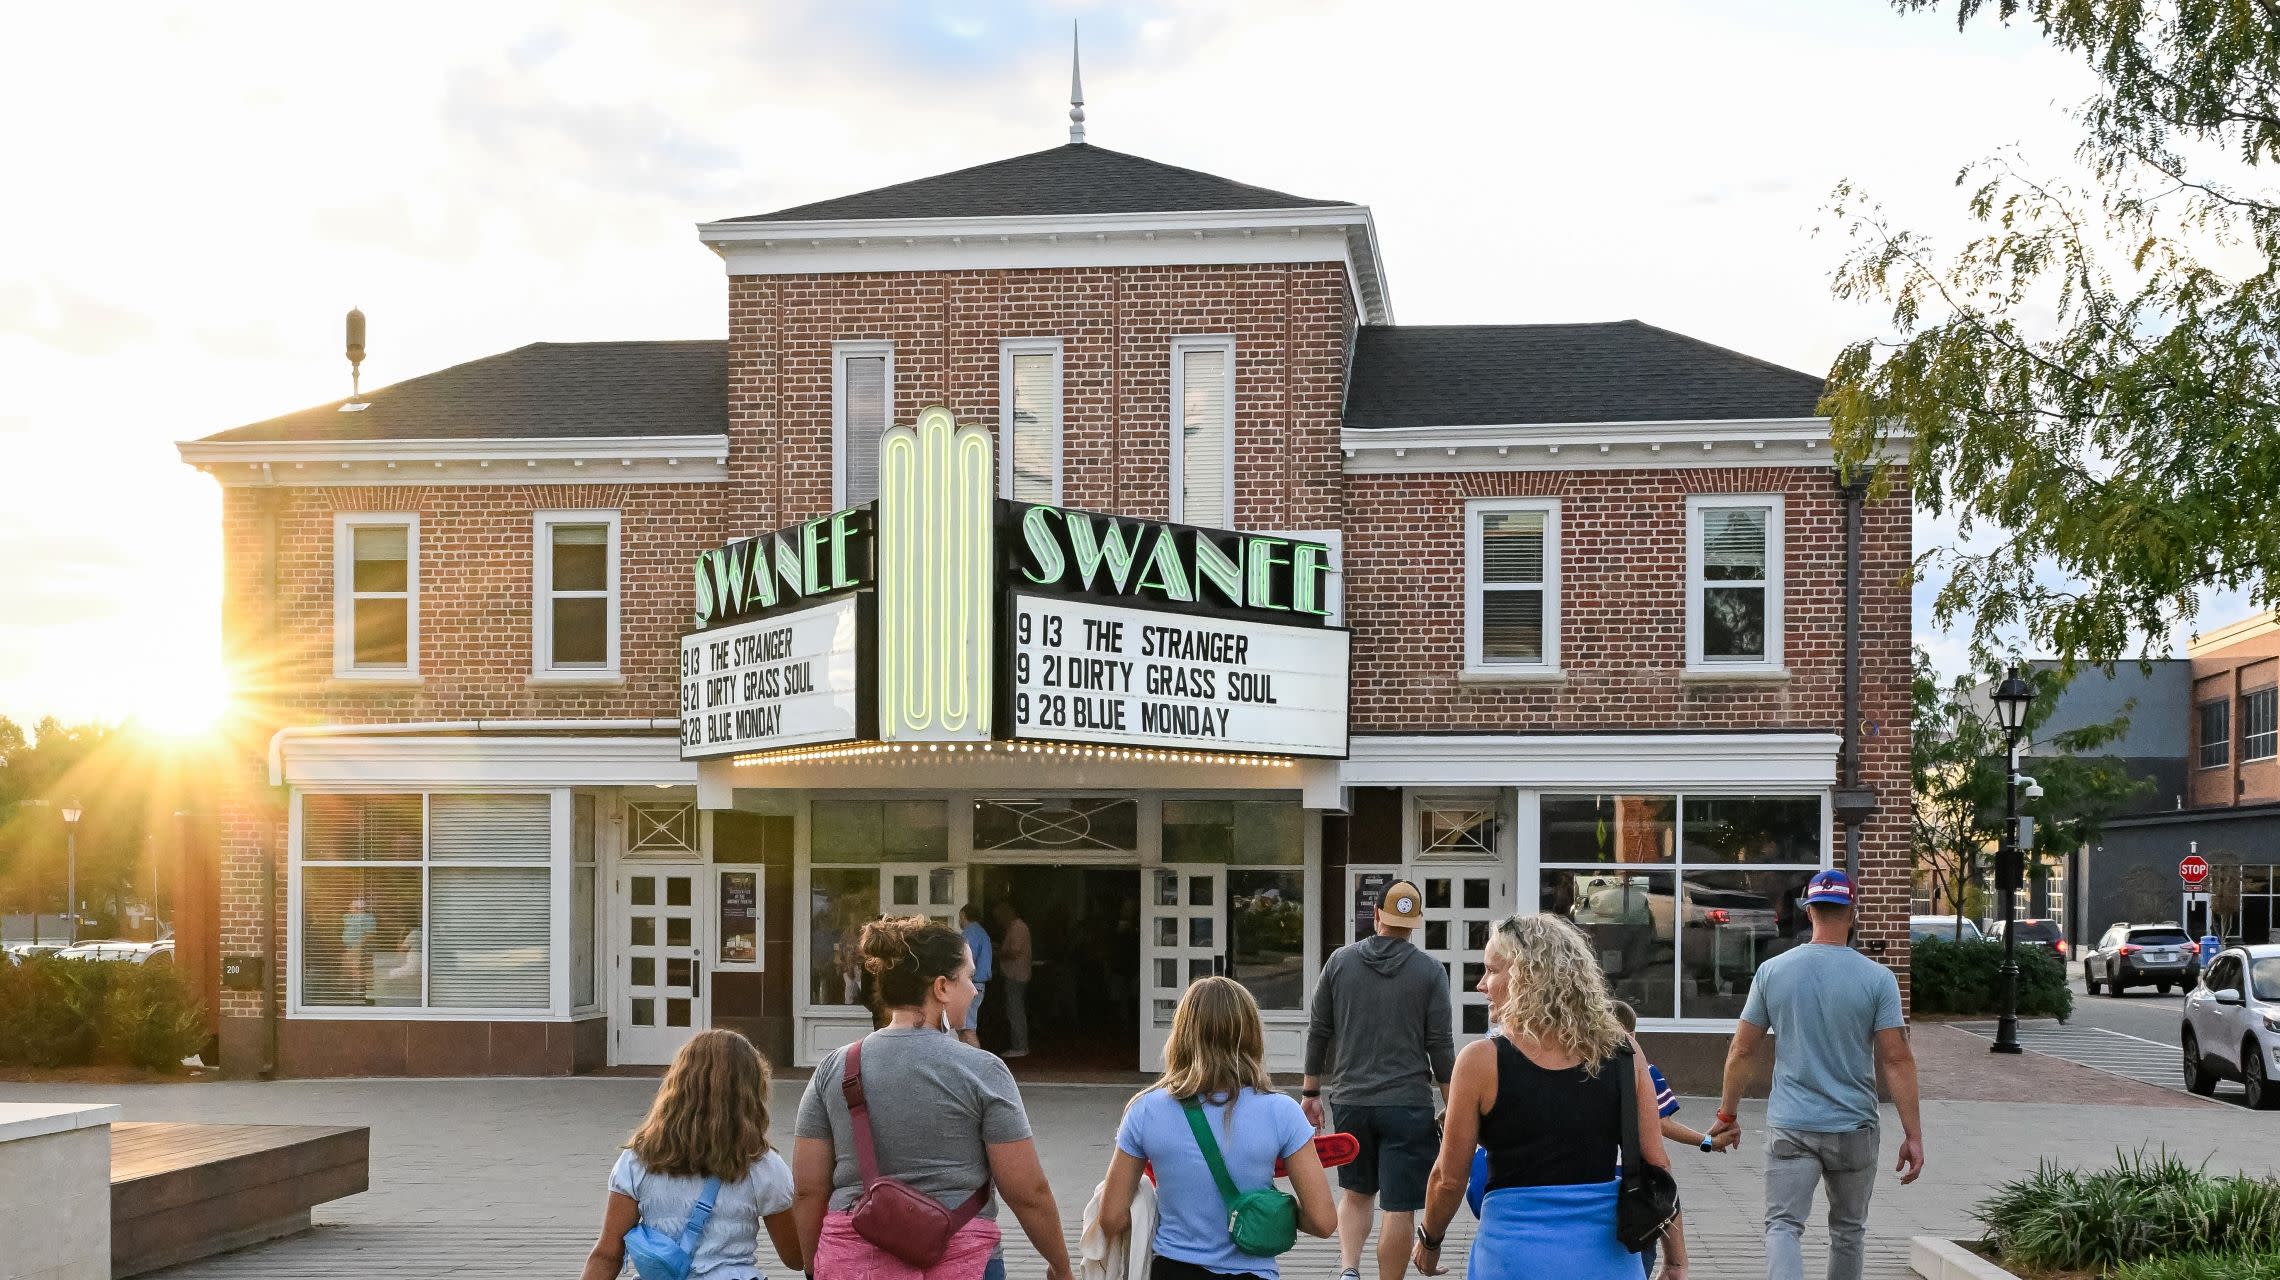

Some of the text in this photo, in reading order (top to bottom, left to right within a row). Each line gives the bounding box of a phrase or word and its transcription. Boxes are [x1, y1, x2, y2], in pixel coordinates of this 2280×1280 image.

[695, 510, 859, 624] SWANEE
[1021, 505, 1335, 616] SWANEE
[709, 640, 730, 672] THE
[734, 627, 793, 667] STRANGER
[1019, 612, 1249, 665] 9 13 THE STRANGER
[707, 675, 737, 708] DIRTY
[743, 667, 780, 702] GRASS
[784, 661, 814, 696] SOUL
[1017, 652, 1030, 684] 9
[1068, 656, 1134, 693] DIRTY
[1146, 663, 1216, 700] GRASS
[1227, 671, 1277, 704] SOUL
[707, 711, 733, 743] BLUE
[735, 704, 781, 740] MONDAY
[1016, 692, 1230, 738] 9 28 BLUE MONDAY
[2181, 864, 2206, 875] STOP
[226, 965, 240, 974] 200
